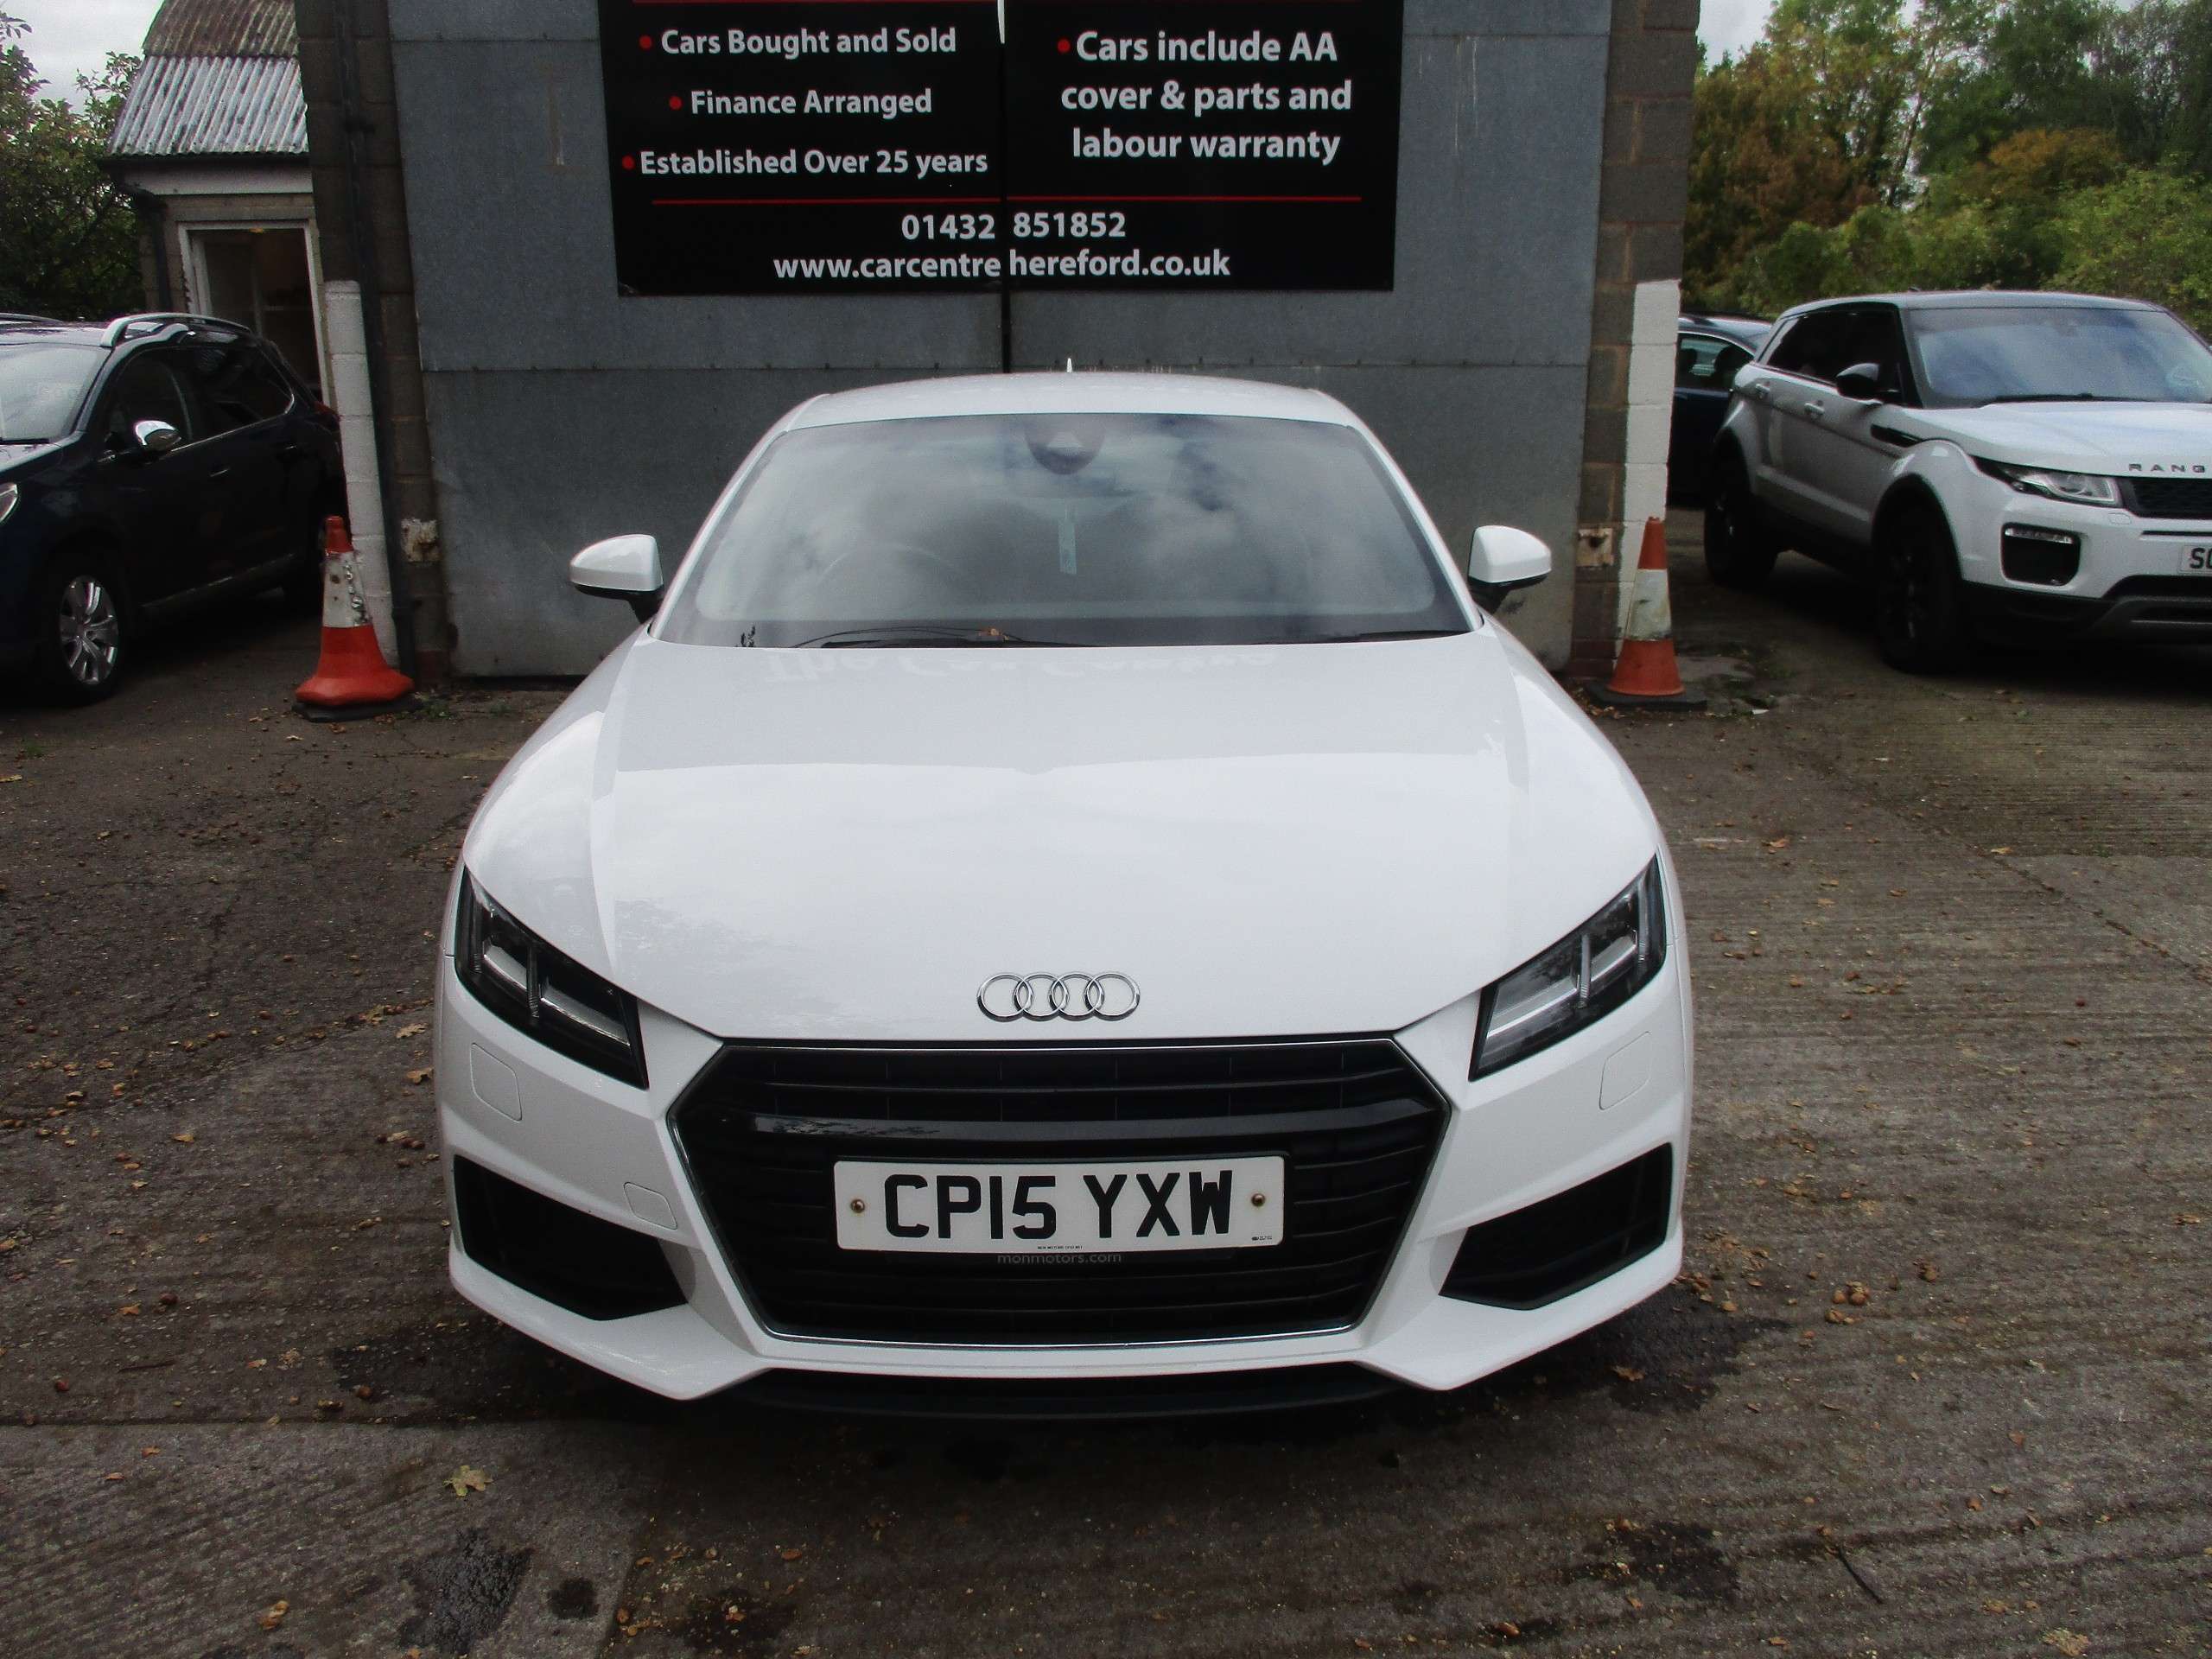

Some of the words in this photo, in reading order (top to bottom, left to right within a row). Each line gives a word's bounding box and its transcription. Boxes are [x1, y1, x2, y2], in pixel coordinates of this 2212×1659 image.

[662, 29, 721, 54] Cars
[728, 28, 830, 60] Bought
[837, 28, 888, 53] and
[896, 27, 956, 53] Sold
[1076, 30, 1148, 61] Cars
[1158, 30, 1281, 61] include
[1288, 31, 1338, 61] AA
[690, 89, 797, 114] Finance
[804, 87, 932, 119] Arranged
[1061, 86, 1153, 110] cover
[1160, 80, 1185, 110] &
[1194, 82, 1281, 117] parts
[1288, 79, 1352, 110] and
[1073, 127, 1182, 158] labour
[1189, 130, 1341, 166] warranty
[640, 149, 797, 175] Established
[804, 149, 869, 174] Over
[876, 149, 909, 174] 25
[915, 154, 988, 180] years
[901, 213, 995, 240] 01432
[1013, 212, 1126, 238] 851852
[2128, 463, 2206, 474] RANG
[883, 1173, 1057, 1240] CP15
[1082, 1169, 1233, 1239] YXW
[997, 1253, 1122, 1265] monmotors.com
